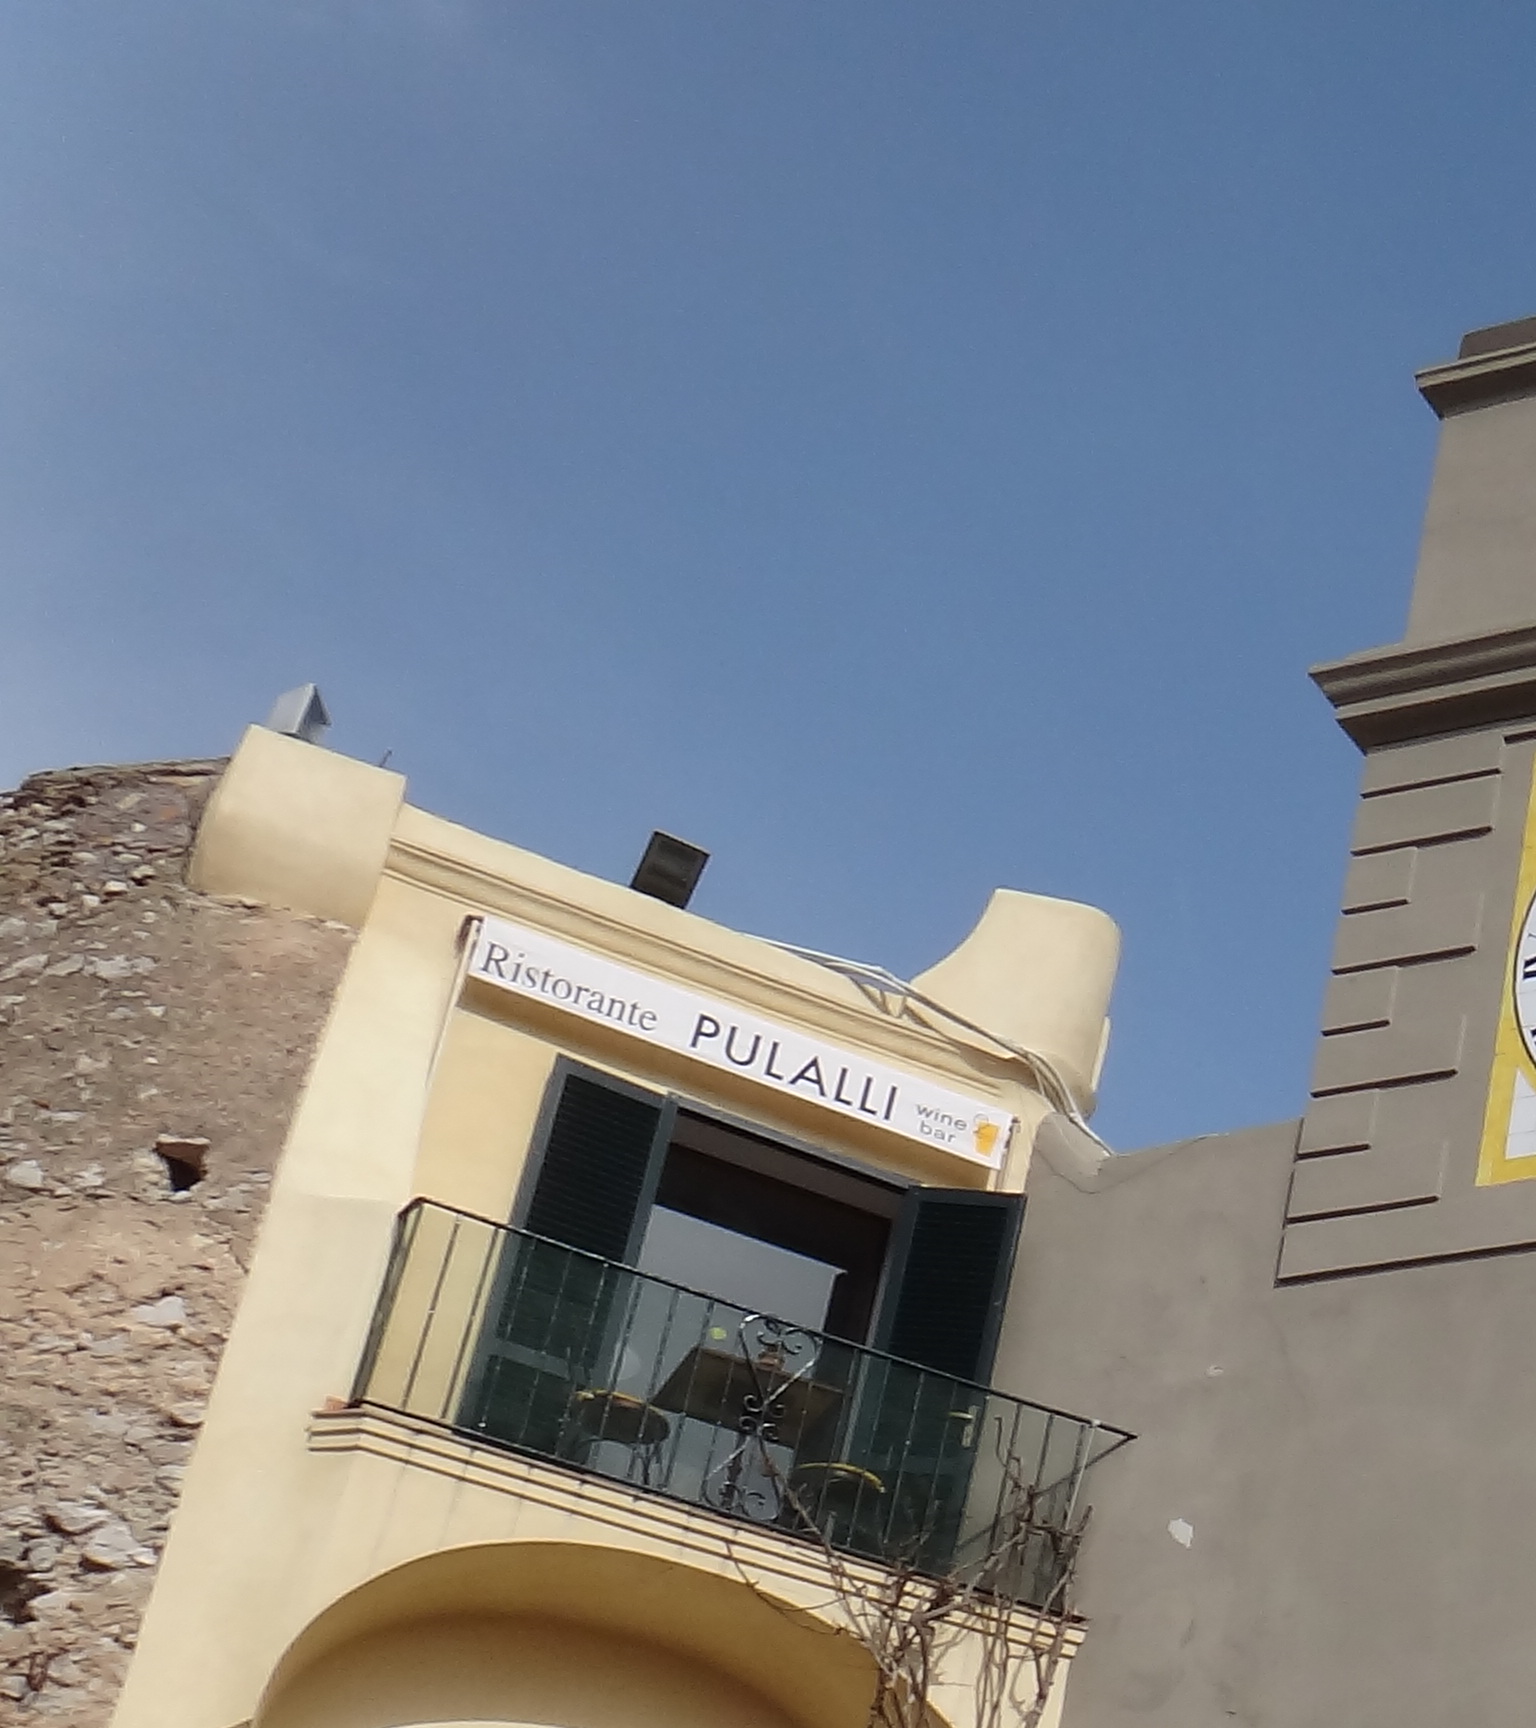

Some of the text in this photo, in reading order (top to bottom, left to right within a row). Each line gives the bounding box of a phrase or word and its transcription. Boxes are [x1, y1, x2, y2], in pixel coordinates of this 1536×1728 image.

[479, 941, 967, 1133] Ristorante PULALLI wine
[919, 1120, 957, 1145] bar
